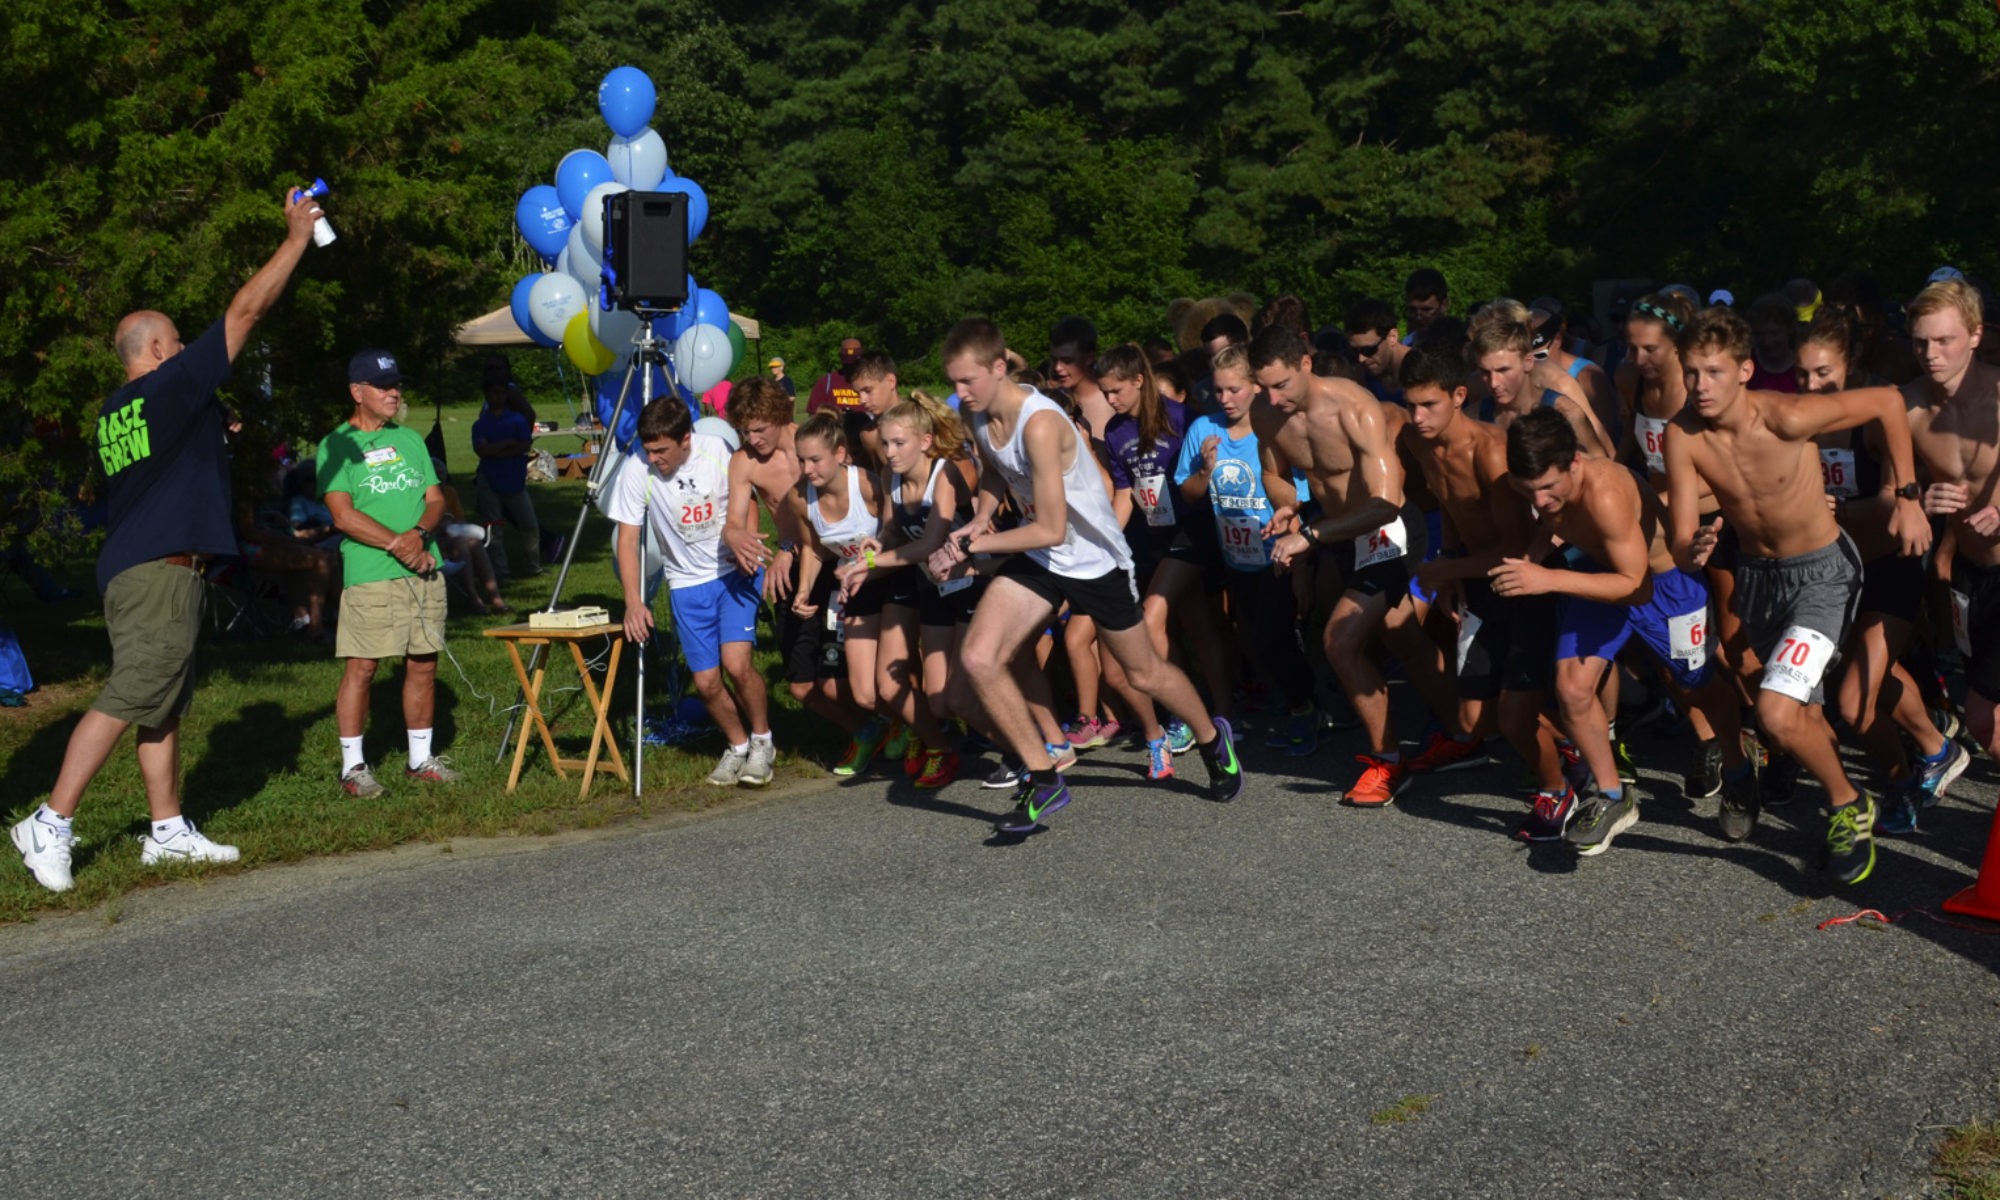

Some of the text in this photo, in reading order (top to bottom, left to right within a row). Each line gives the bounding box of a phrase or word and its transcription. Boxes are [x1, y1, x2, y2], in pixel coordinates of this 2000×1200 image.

[837, 397, 861, 405] RAIDE
[98, 398, 146, 445] RACE
[99, 426, 150, 476] CREW
[1140, 488, 1158, 506] 96
[682, 503, 712, 524] 263
[1224, 525, 1251, 546] 197
[1368, 529, 1390, 554] 54
[1777, 638, 1810, 666] 70
